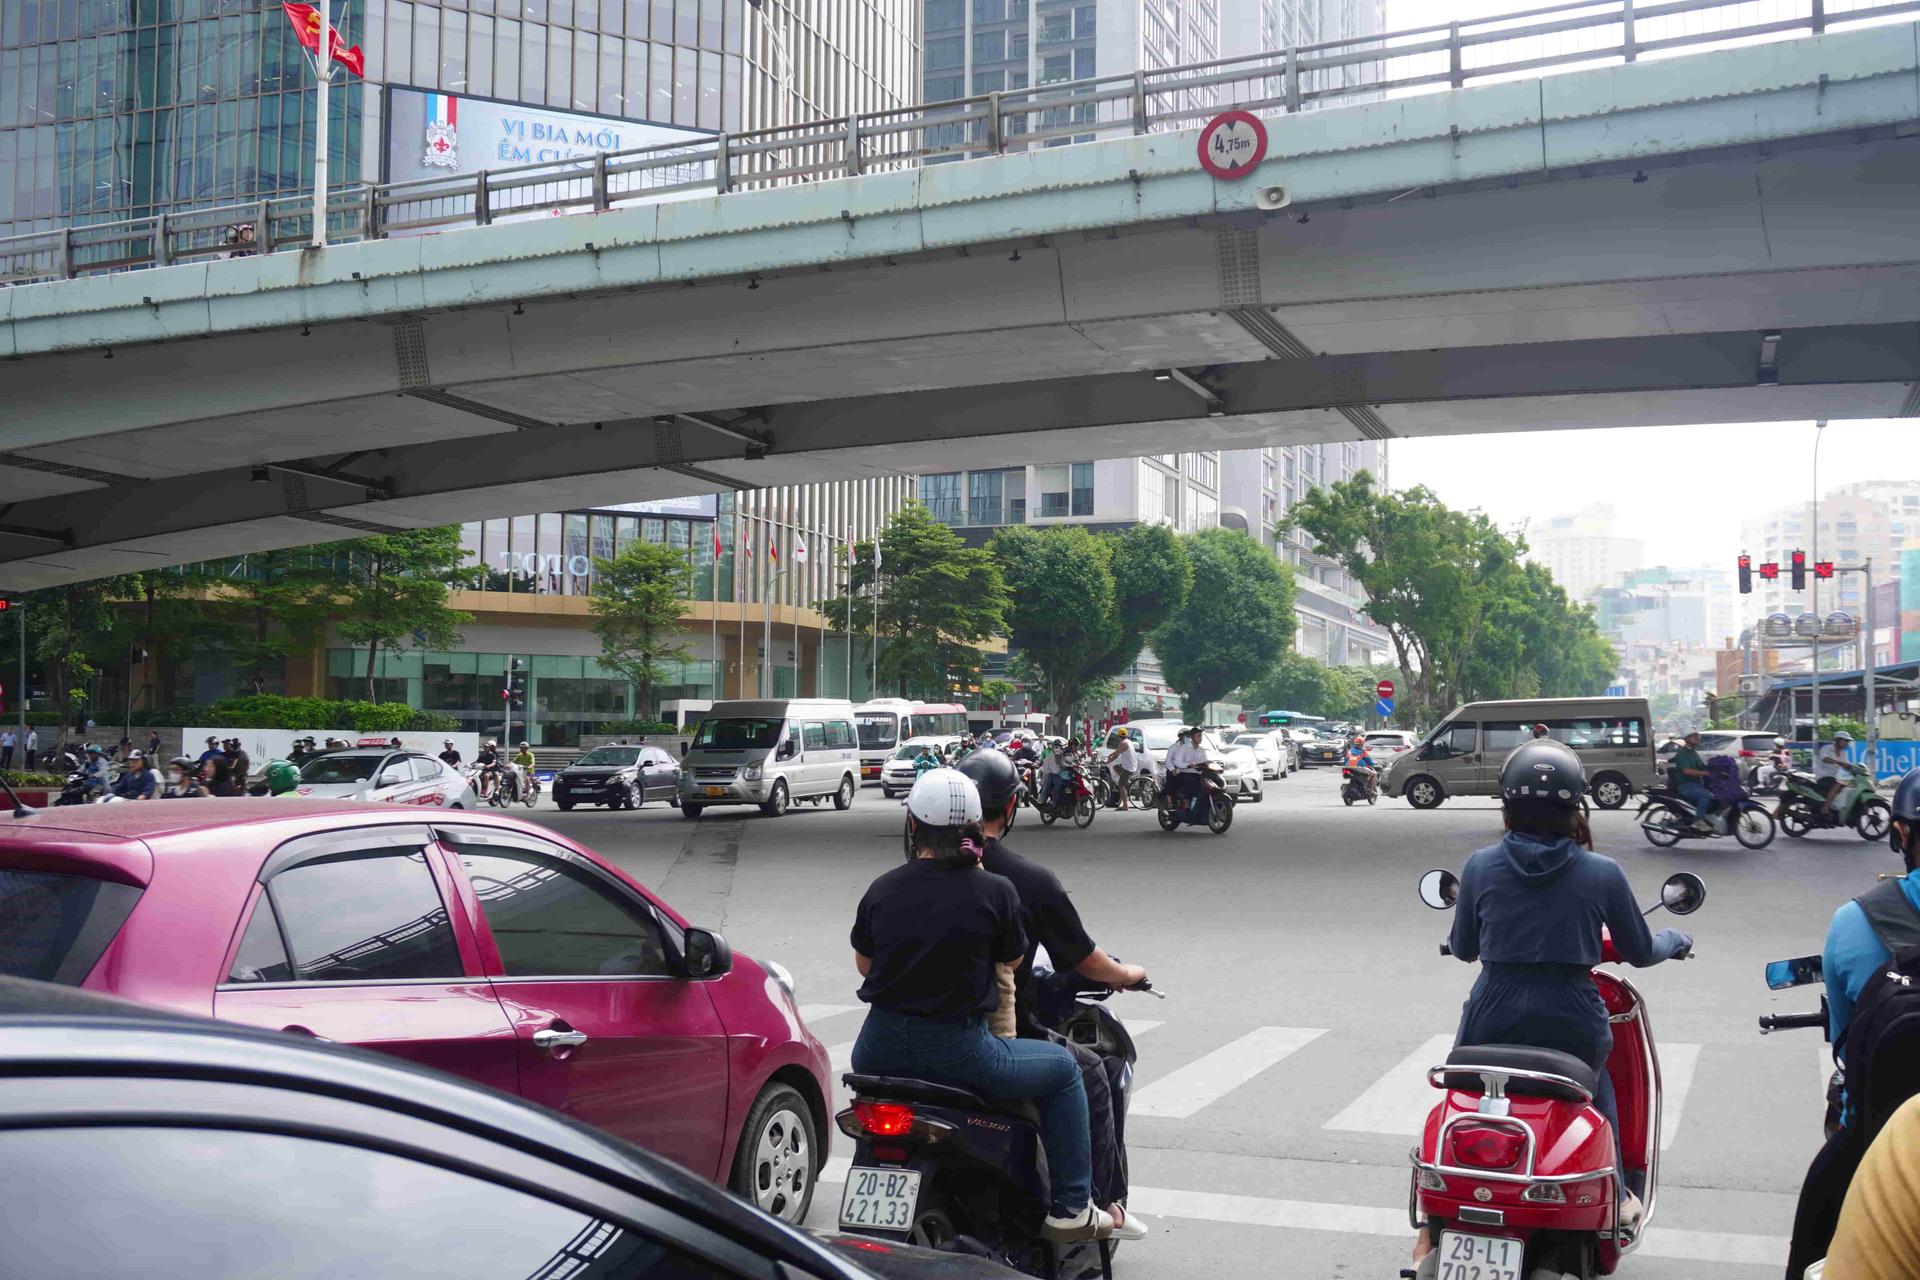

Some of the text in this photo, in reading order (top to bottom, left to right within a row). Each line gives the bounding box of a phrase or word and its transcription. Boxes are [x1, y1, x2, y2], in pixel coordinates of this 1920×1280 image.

[501, 118, 526, 141] VỊ
[531, 122, 569, 143] BIA
[498, 138, 531, 162] ÊM
[1214, 134, 1250, 155] 4,75m
[500, 551, 589, 576] TOTO
[1815, 563, 1833, 577] 42
[856, 1172, 908, 1198] 20-B2
[845, 1198, 910, 1226] 421.33
[1451, 1235, 1509, 1266] 29-L1
